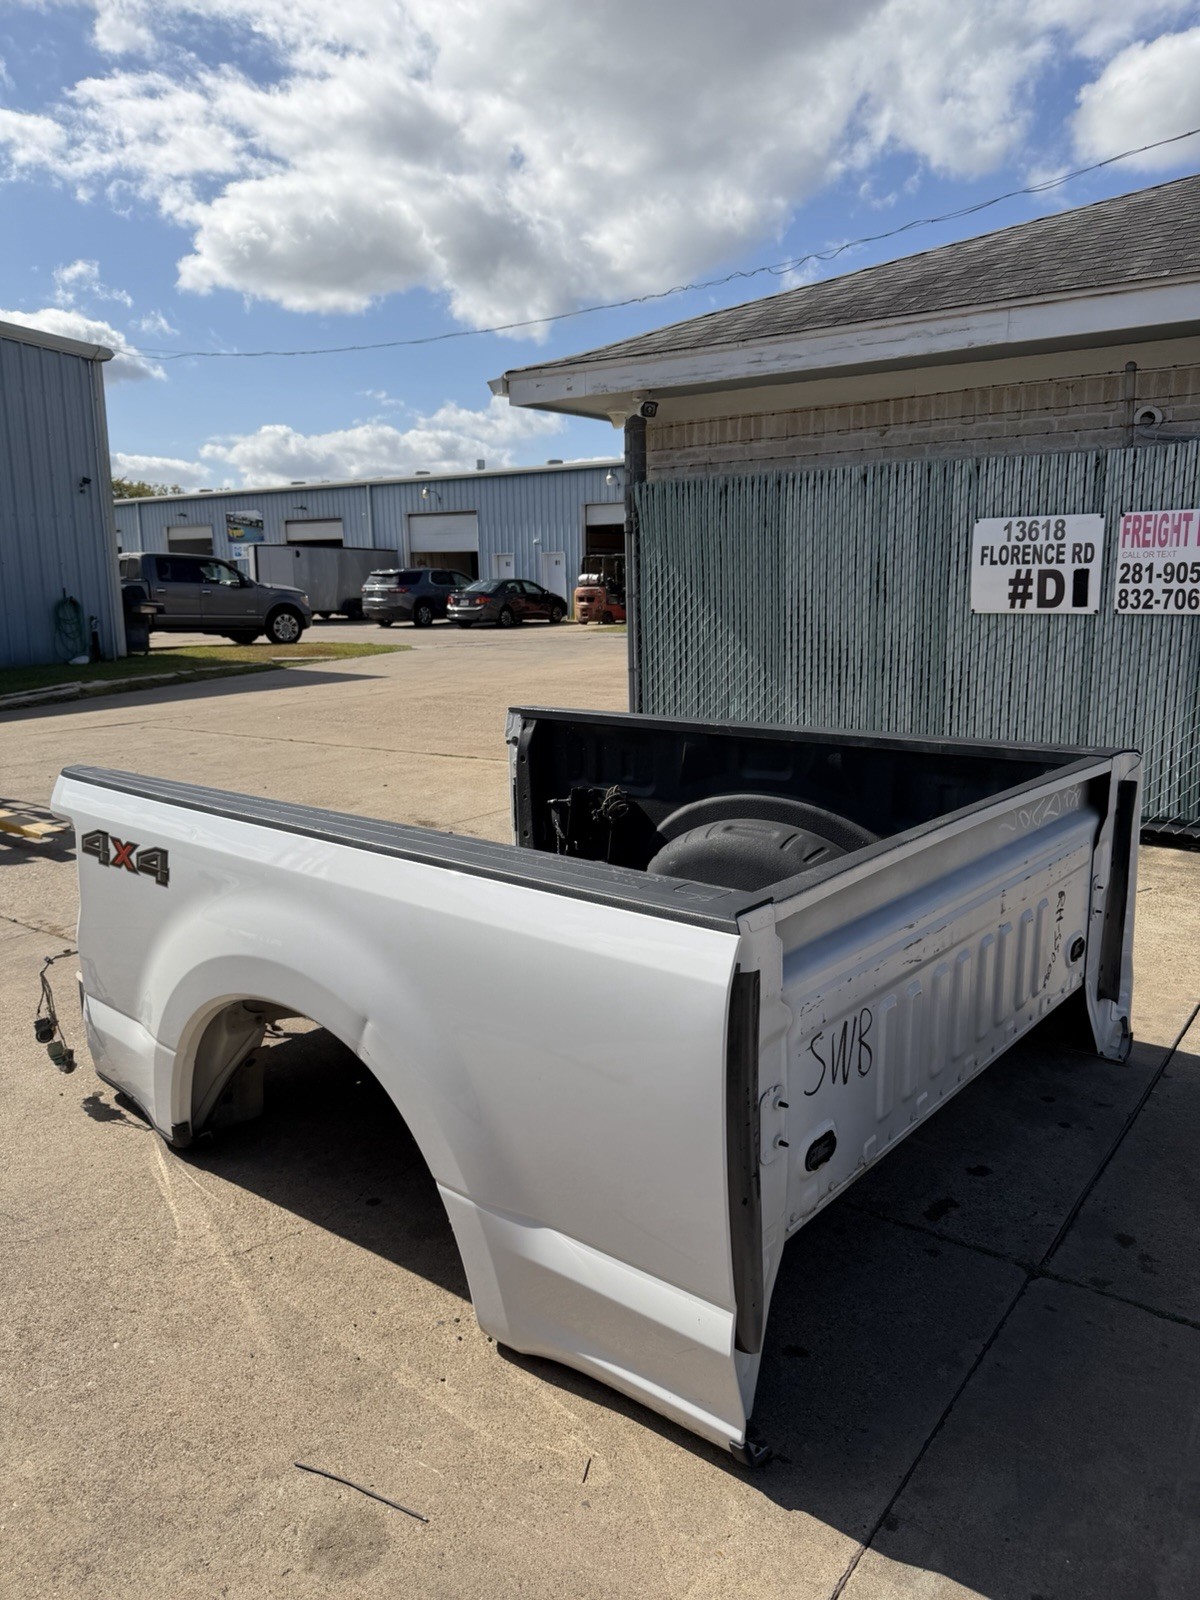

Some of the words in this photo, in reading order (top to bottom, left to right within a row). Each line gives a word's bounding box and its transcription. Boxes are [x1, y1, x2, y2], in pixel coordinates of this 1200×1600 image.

[1003, 519, 1066, 542] 13618
[1121, 512, 1194, 549] FREIGHT
[980, 543, 1066, 566] FLORENCE
[1071, 542, 1095, 564] RD
[1121, 551, 1141, 559] CALL
[1156, 550, 1177, 558] TEXT
[1118, 561, 1200, 584] 281-905
[1117, 588, 1200, 610] 832-706
[804, 1007, 873, 1096] SWB
